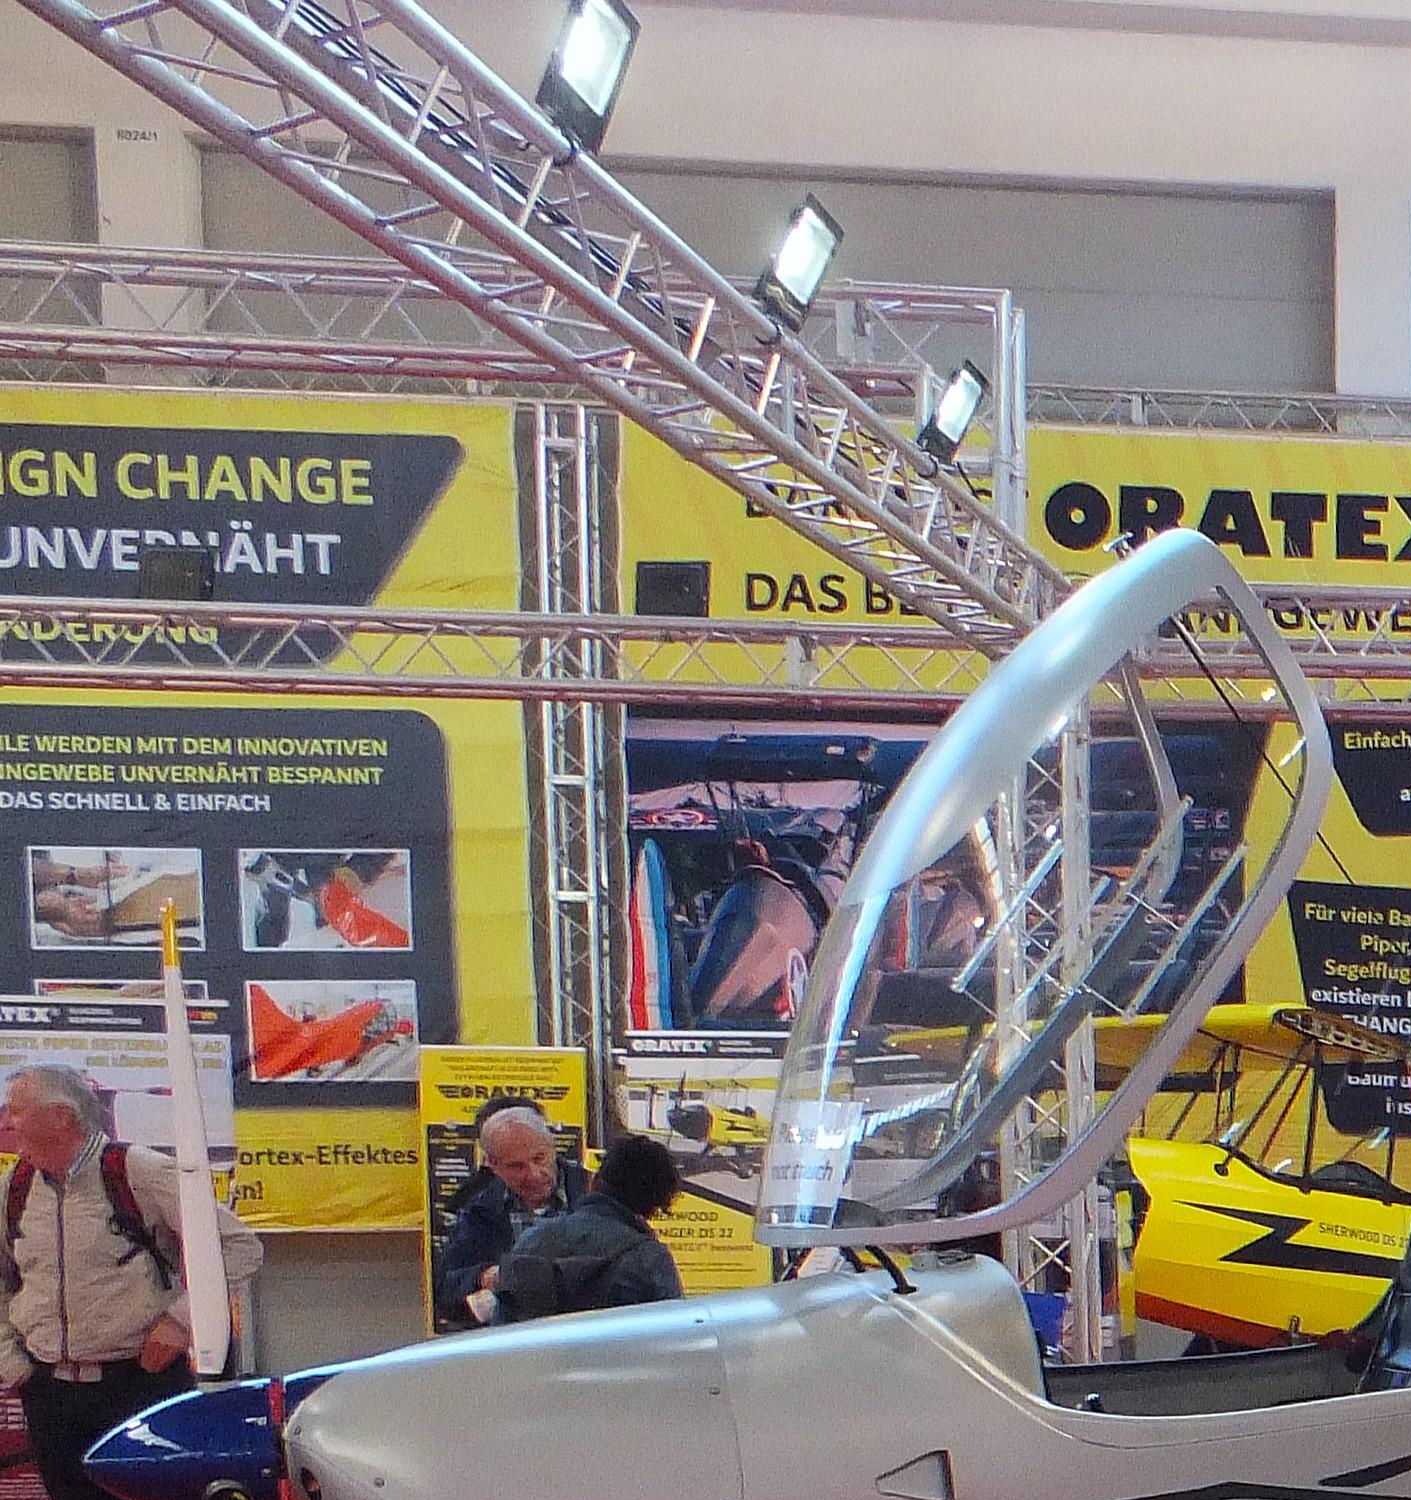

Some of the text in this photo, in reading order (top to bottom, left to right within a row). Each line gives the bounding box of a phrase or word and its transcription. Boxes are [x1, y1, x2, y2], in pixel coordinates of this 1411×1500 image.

[116, 453, 374, 505] CHANGE
[745, 572, 848, 614] DAS
[34, 735, 132, 754] WERDEN
[137, 737, 178, 755] MIT
[183, 738, 232, 756] DEM
[238, 739, 389, 758] INNOVATIVEN
[1343, 731, 1411, 751] Einfach
[120, 762, 261, 784] UNVERNÄHT
[268, 766, 383, 786] BESPANNT
[0, 791, 271, 813] DAS SCHNELL & EINFACH
[1304, 902, 1336, 922] Für
[1360, 934, 1411, 957] Piper,
[1311, 987, 1402, 1009] existieren
[632, 1039, 707, 1054] ORATEX
[239, 1144, 419, 1167] ortex-Effektes
[1319, 1222, 1380, 1244] SHERWOOD
